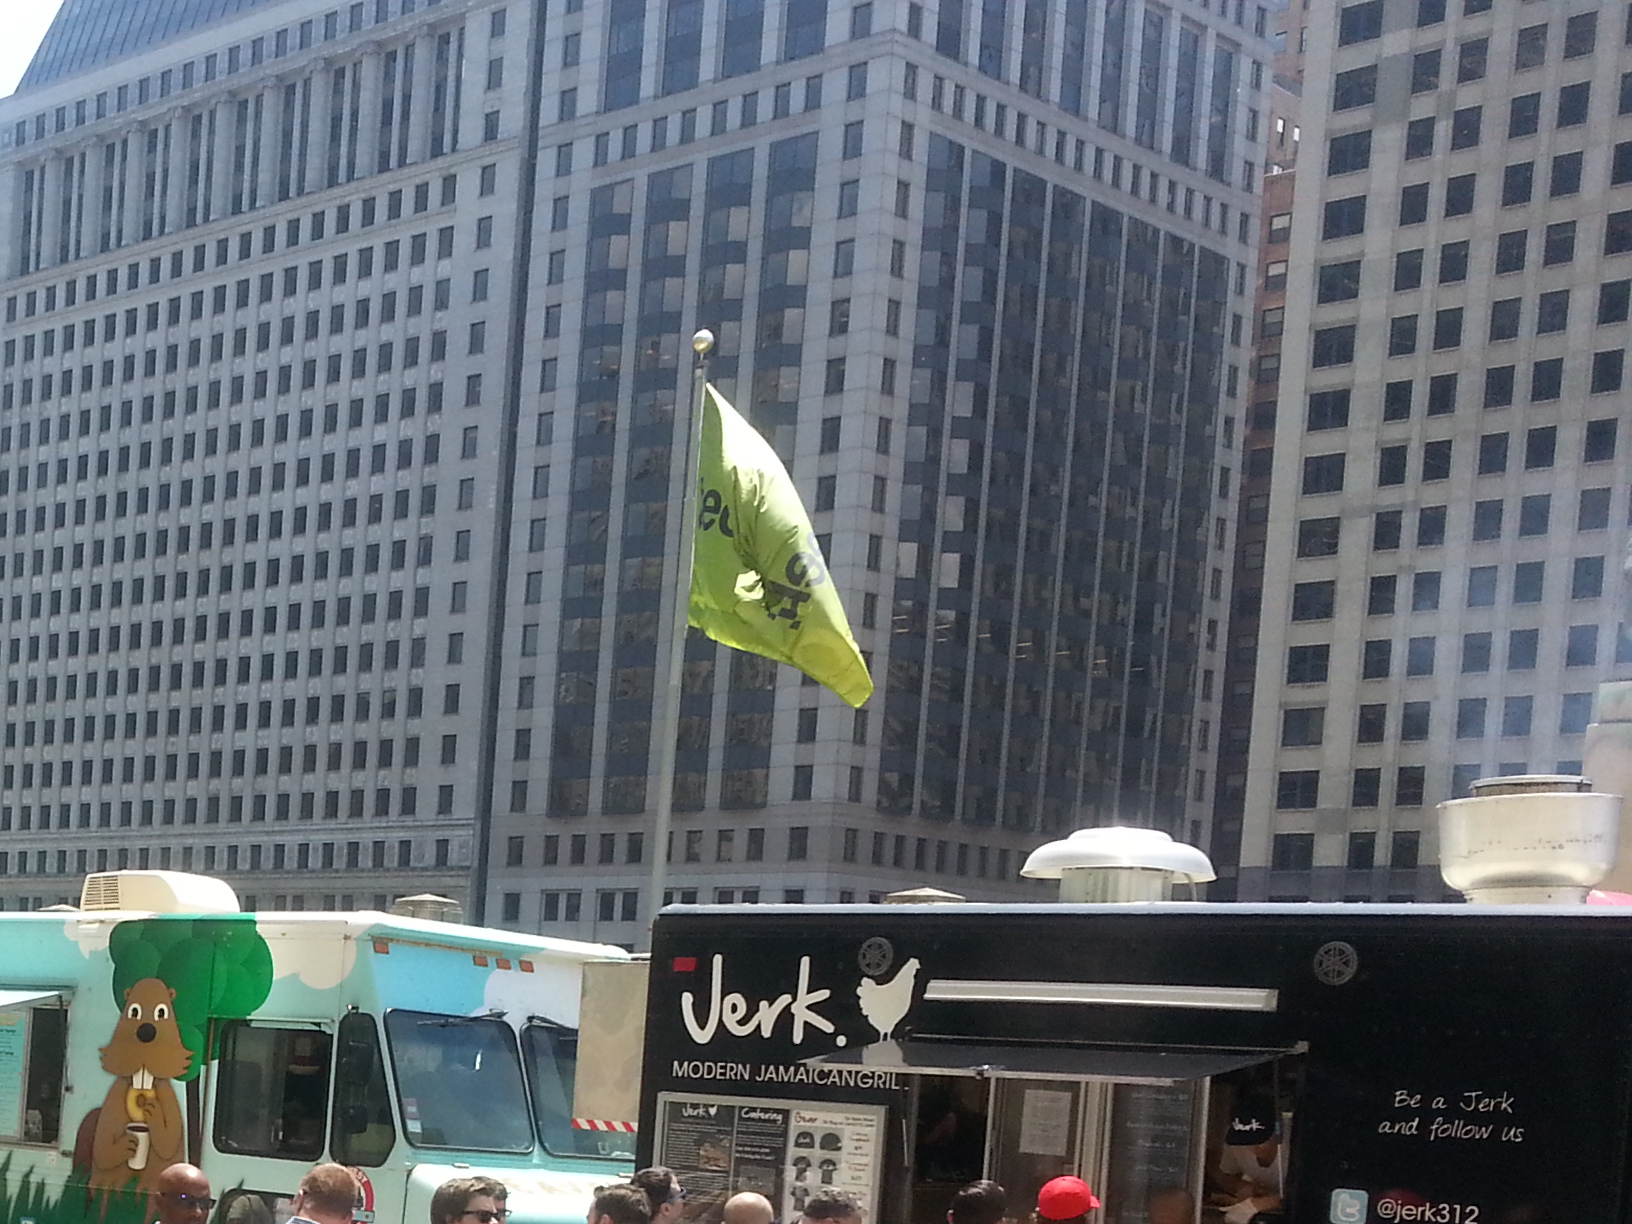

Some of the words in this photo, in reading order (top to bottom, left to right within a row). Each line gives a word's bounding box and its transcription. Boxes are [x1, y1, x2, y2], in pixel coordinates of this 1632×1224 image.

[681, 953, 847, 1047] Jerk.
[672, 1060, 750, 1081] MODERN
[1394, 1090, 1422, 1108] Be
[1431, 1094, 1448, 1109] a
[1459, 1091, 1514, 1114] Jerk
[1378, 1117, 1419, 1135] and
[1429, 1116, 1494, 1142] follow
[1501, 1127, 1525, 1142] us
[1377, 1199, 1479, 1224] @jerk312
